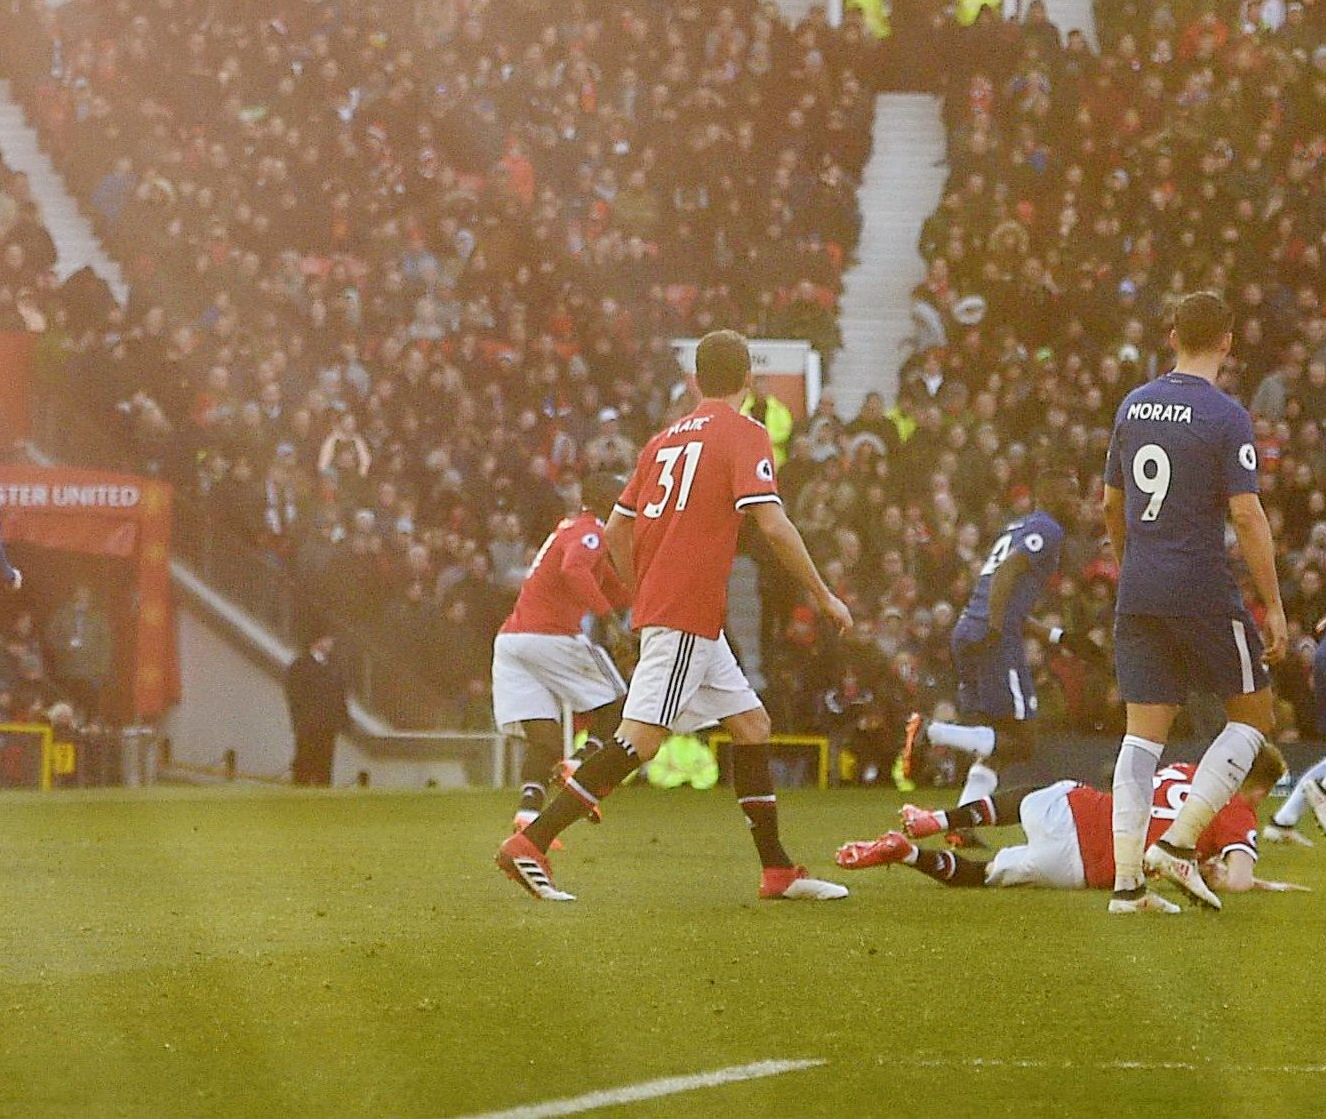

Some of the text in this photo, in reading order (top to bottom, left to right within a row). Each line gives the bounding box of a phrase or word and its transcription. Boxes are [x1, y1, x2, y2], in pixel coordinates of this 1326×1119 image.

[1126, 402, 1193, 424] MORATA
[52, 484, 141, 507] UNITED
[642, 441, 704, 518] 31
[1132, 443, 1172, 522] 9
